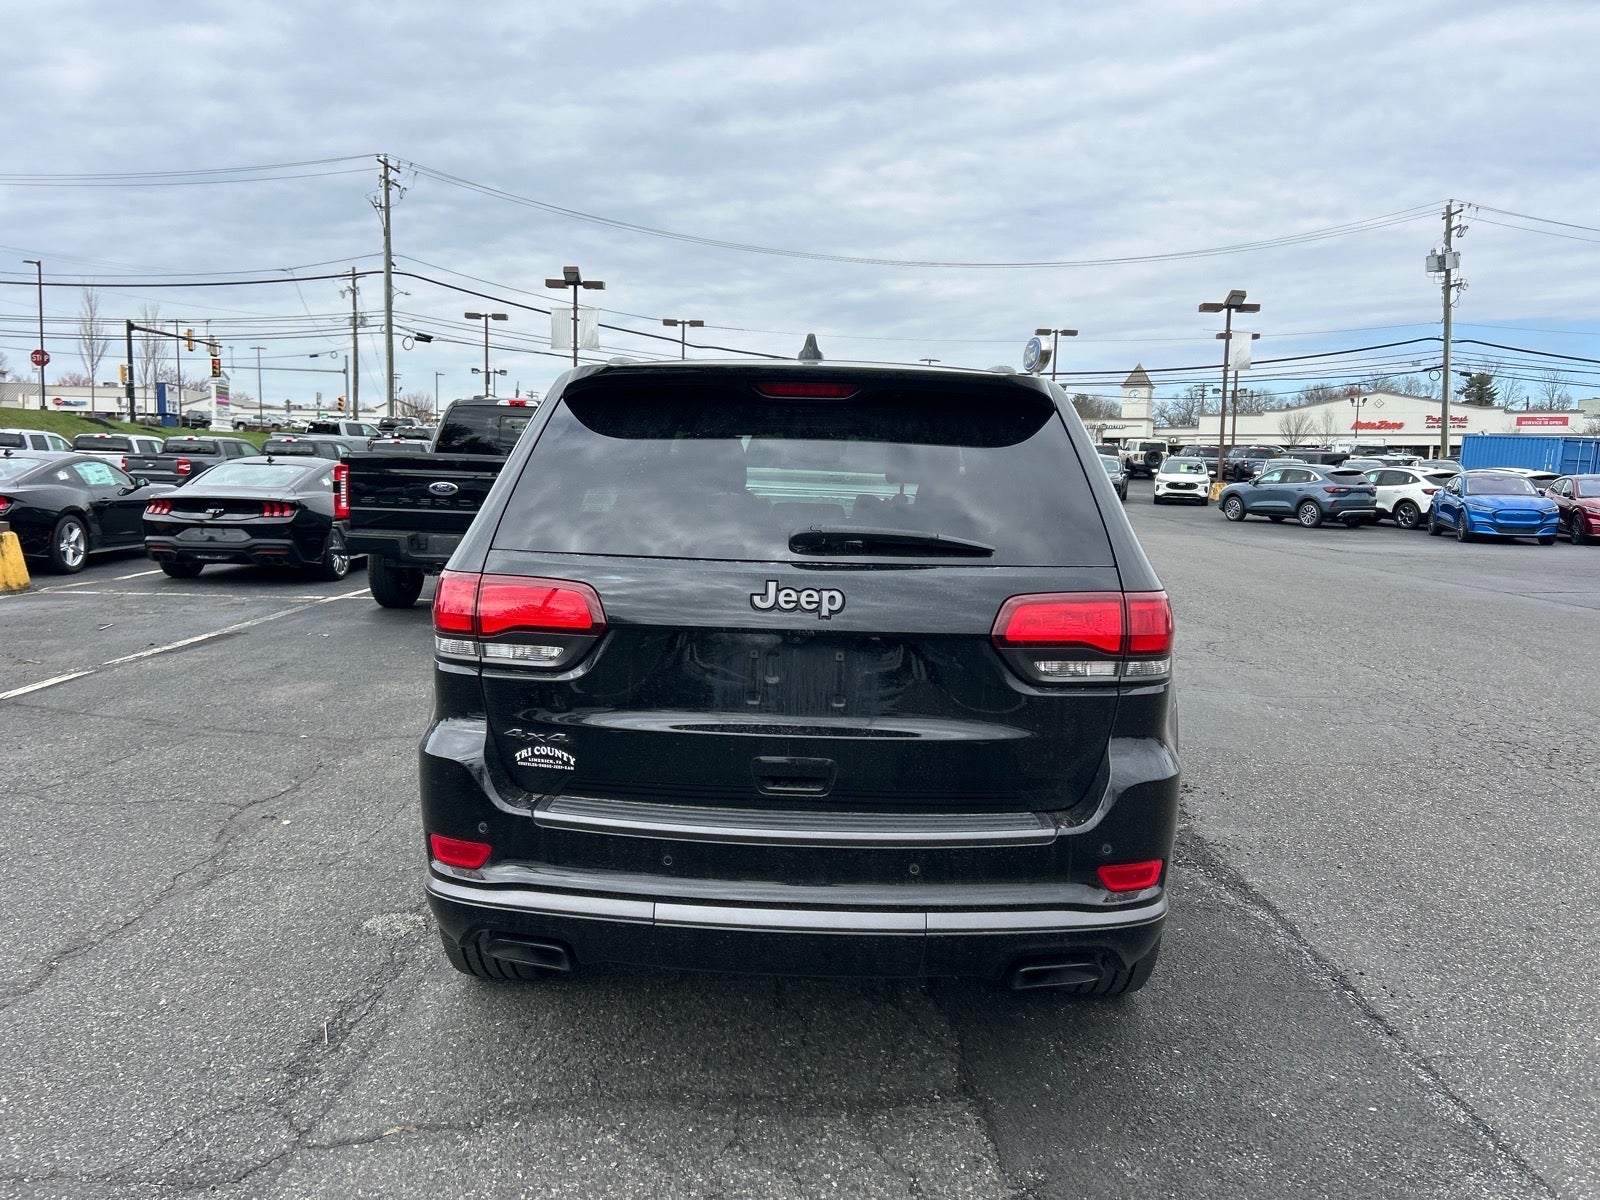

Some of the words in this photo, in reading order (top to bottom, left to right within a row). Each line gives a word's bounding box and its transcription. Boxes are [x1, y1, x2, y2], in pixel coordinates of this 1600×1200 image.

[750, 580, 845, 619] Jeep
[514, 747, 532, 761] TRI
[534, 746, 576, 766] COUNTY
